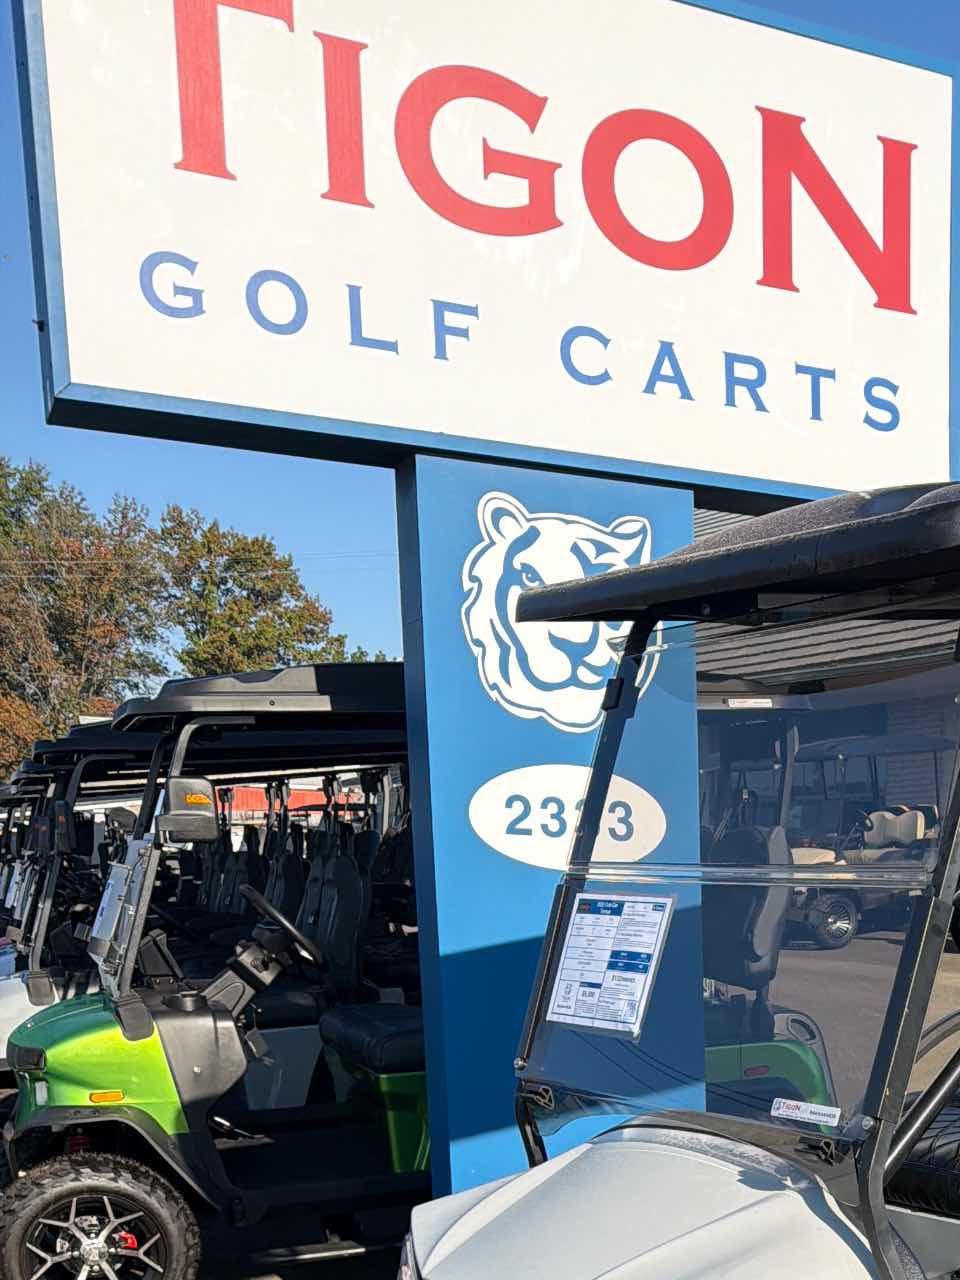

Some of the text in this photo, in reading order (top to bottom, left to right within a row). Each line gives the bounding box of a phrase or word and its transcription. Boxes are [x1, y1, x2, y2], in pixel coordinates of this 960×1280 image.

[172, 0, 918, 316] TIGON
[139, 250, 902, 433] GOLF CARTS
[504, 794, 635, 842] 233
